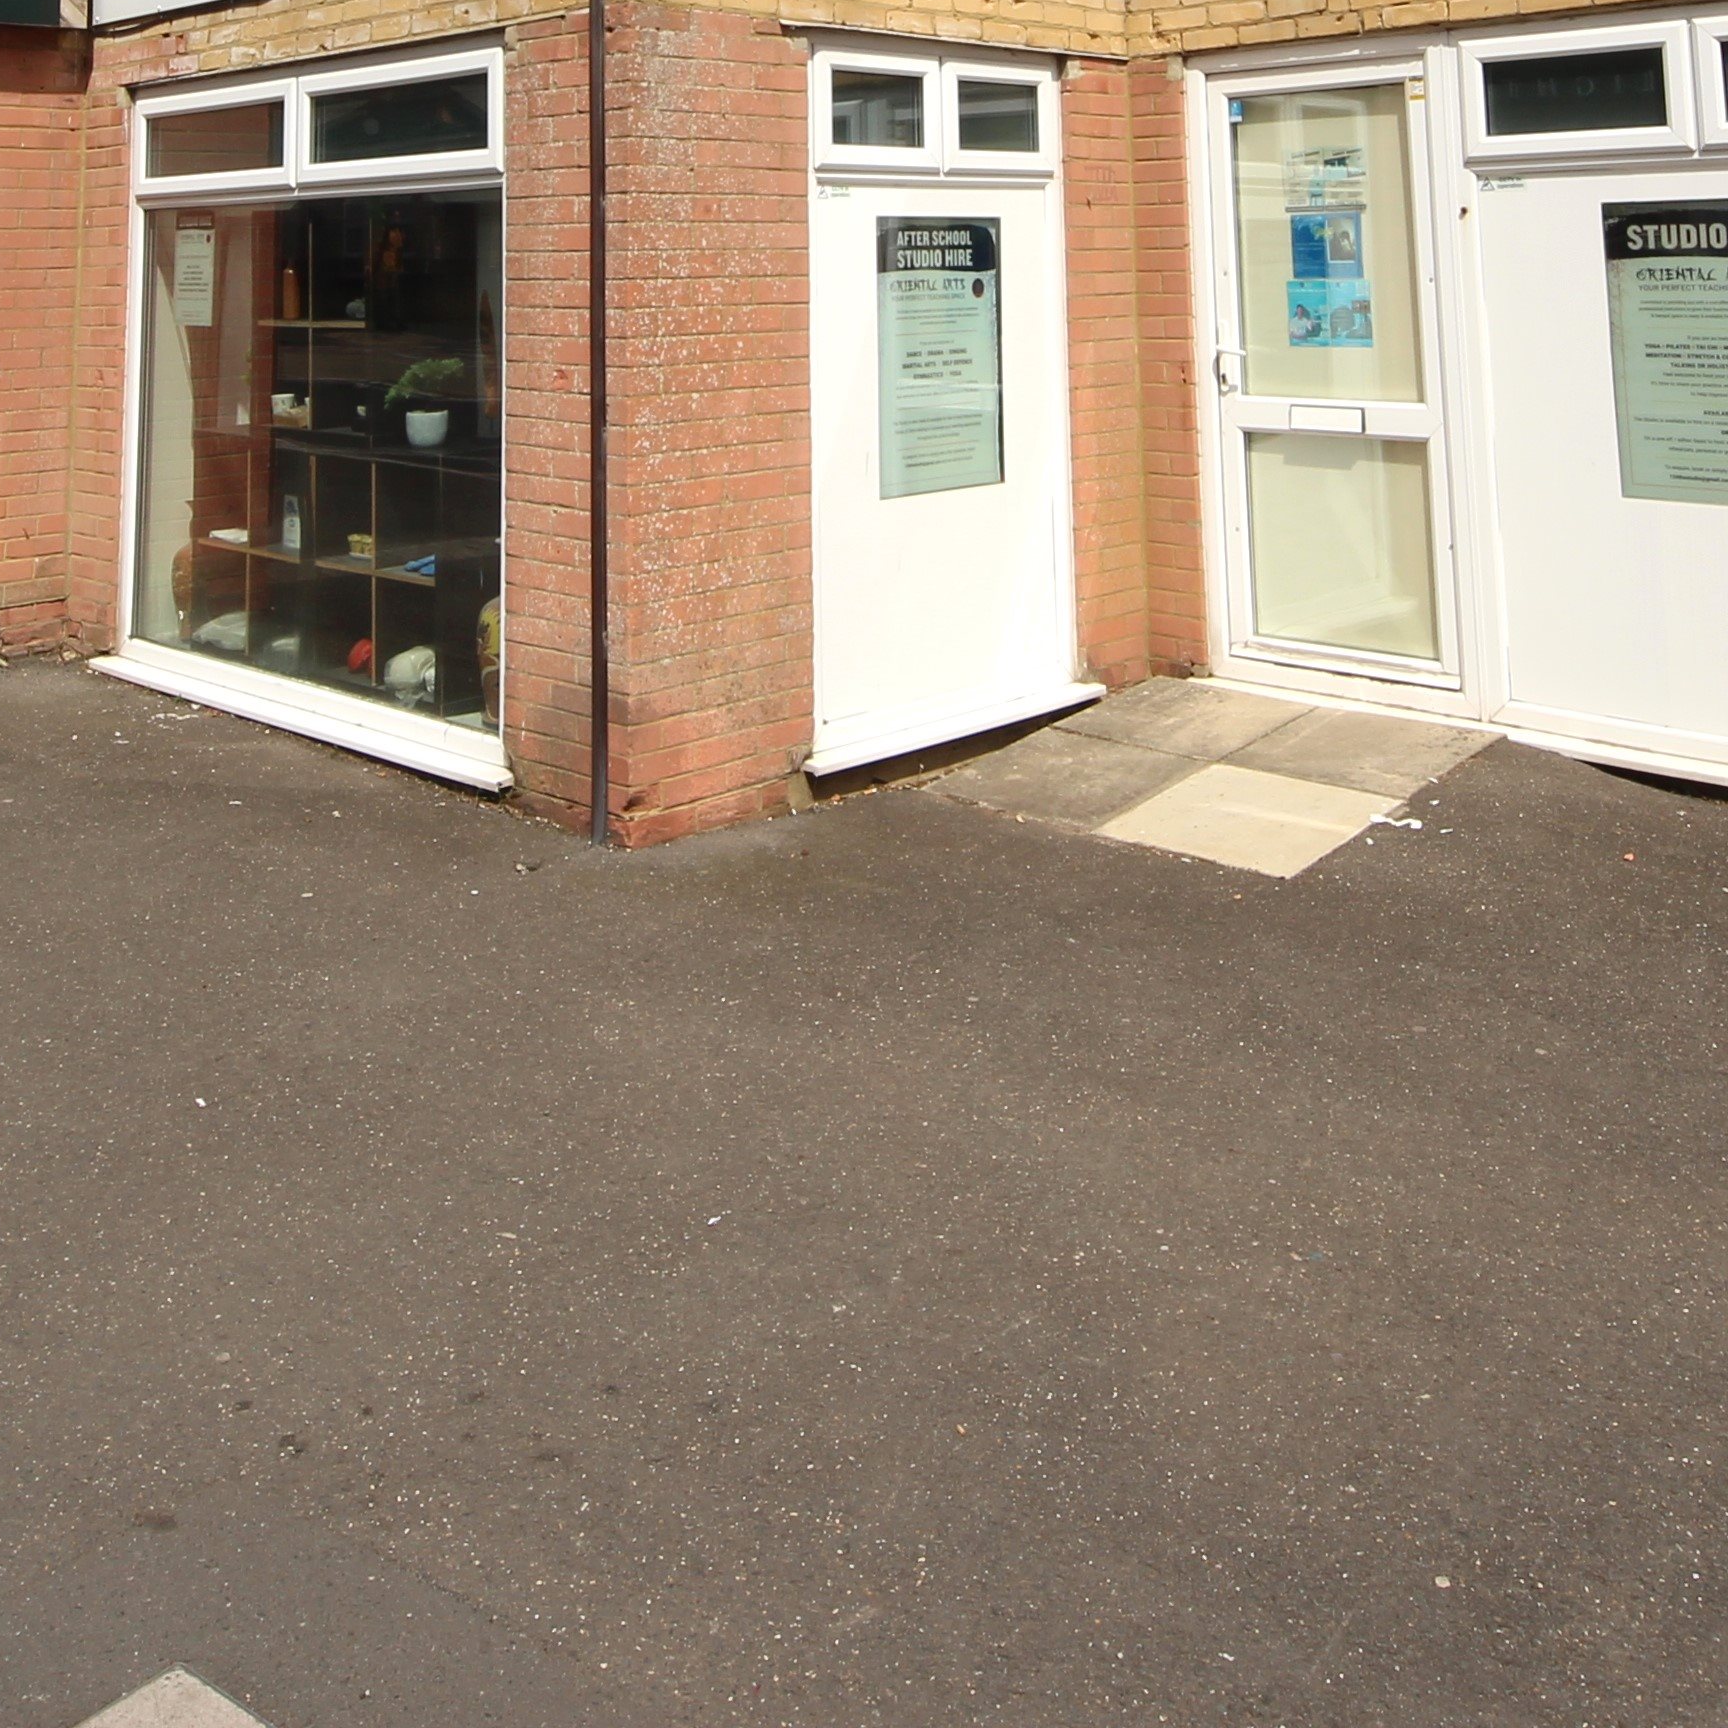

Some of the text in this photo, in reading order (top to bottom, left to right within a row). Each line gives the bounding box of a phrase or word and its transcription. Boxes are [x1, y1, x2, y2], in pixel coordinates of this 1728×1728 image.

[897, 230, 972, 247] AFTER SCHOOL
[1627, 223, 1728, 251] STUDIO
[897, 248, 973, 269] STUDIO HIRE
[1636, 266, 1718, 283] ORIENTAL
[1638, 284, 1659, 292] YOUR
[1661, 284, 1696, 292] PERFECT
